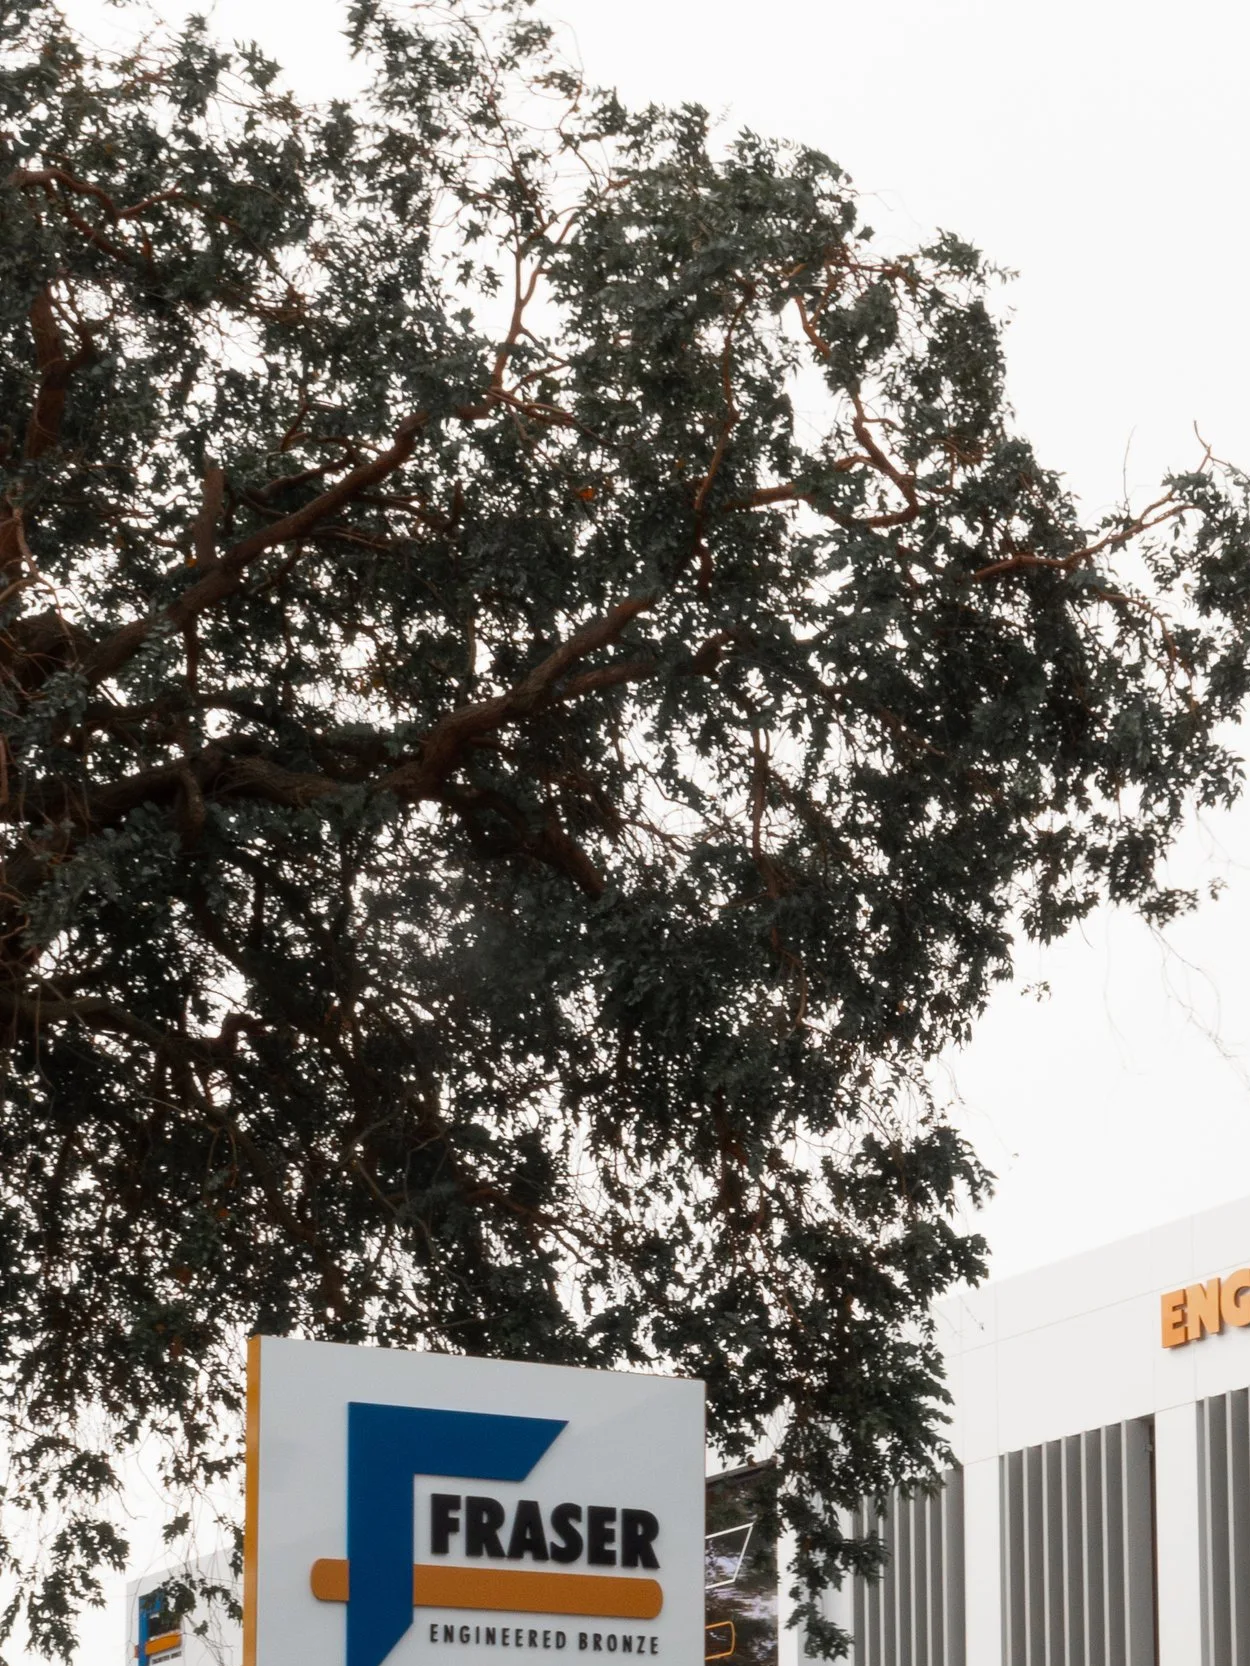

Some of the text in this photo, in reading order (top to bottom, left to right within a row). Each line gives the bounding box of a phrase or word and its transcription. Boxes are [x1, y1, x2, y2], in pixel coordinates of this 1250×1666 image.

[430, 1493, 660, 1570] FRASER
[430, 1624, 659, 1655] ENGINEERED BRONZE
